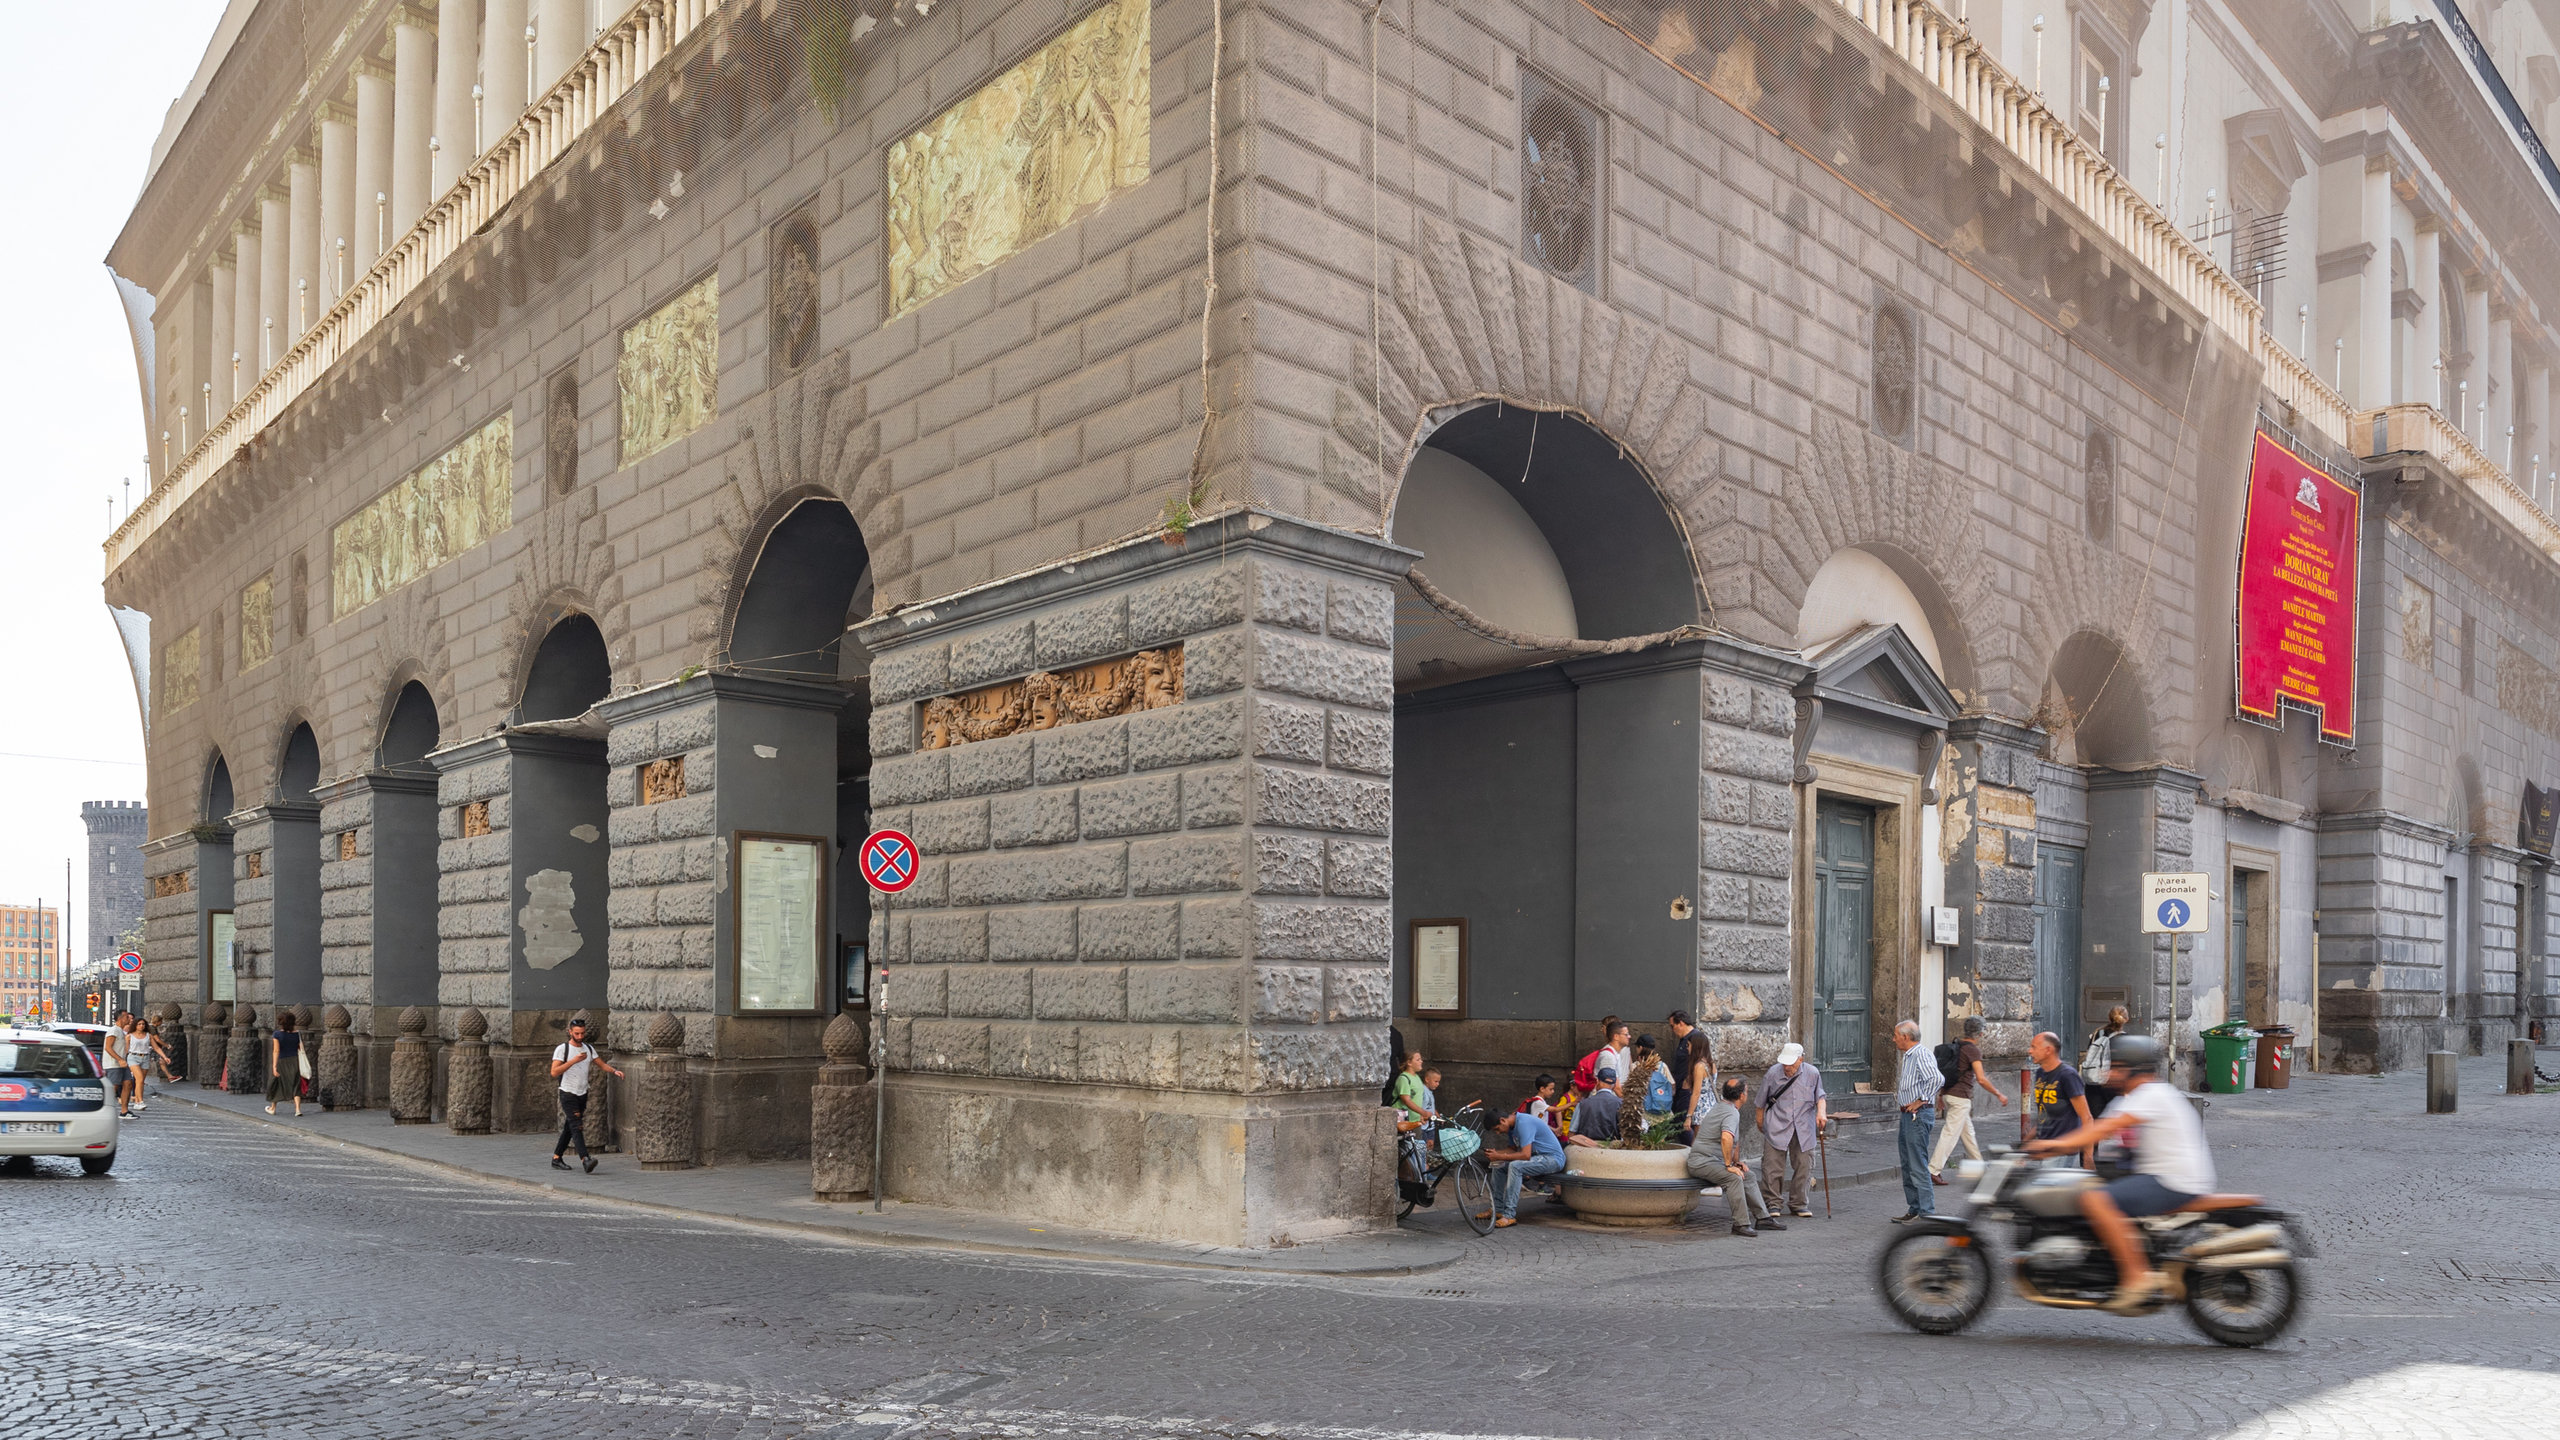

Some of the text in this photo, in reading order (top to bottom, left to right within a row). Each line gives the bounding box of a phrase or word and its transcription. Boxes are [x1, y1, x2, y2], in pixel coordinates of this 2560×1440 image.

[2285, 553, 2311, 577] DORIAN
[2312, 566, 2329, 586] GRAY
[2273, 565, 2281, 578] LA
[2281, 568, 2308, 590] BELLEZZA
[2307, 580, 2318, 594] NON
[2317, 586, 2325, 598] HA
[2325, 588, 2338, 603] PIETÀ
[2283, 600, 2305, 618] DANIELE
[2305, 609, 2326, 625] MARTINI
[2281, 640, 2326, 664] EMANUELE GAMBA
[2285, 627, 2323, 652] WAYNE FOWKES
[2283, 675, 2319, 696] PIERRE CARDIN
[2155, 886, 2197, 894] pedonale
